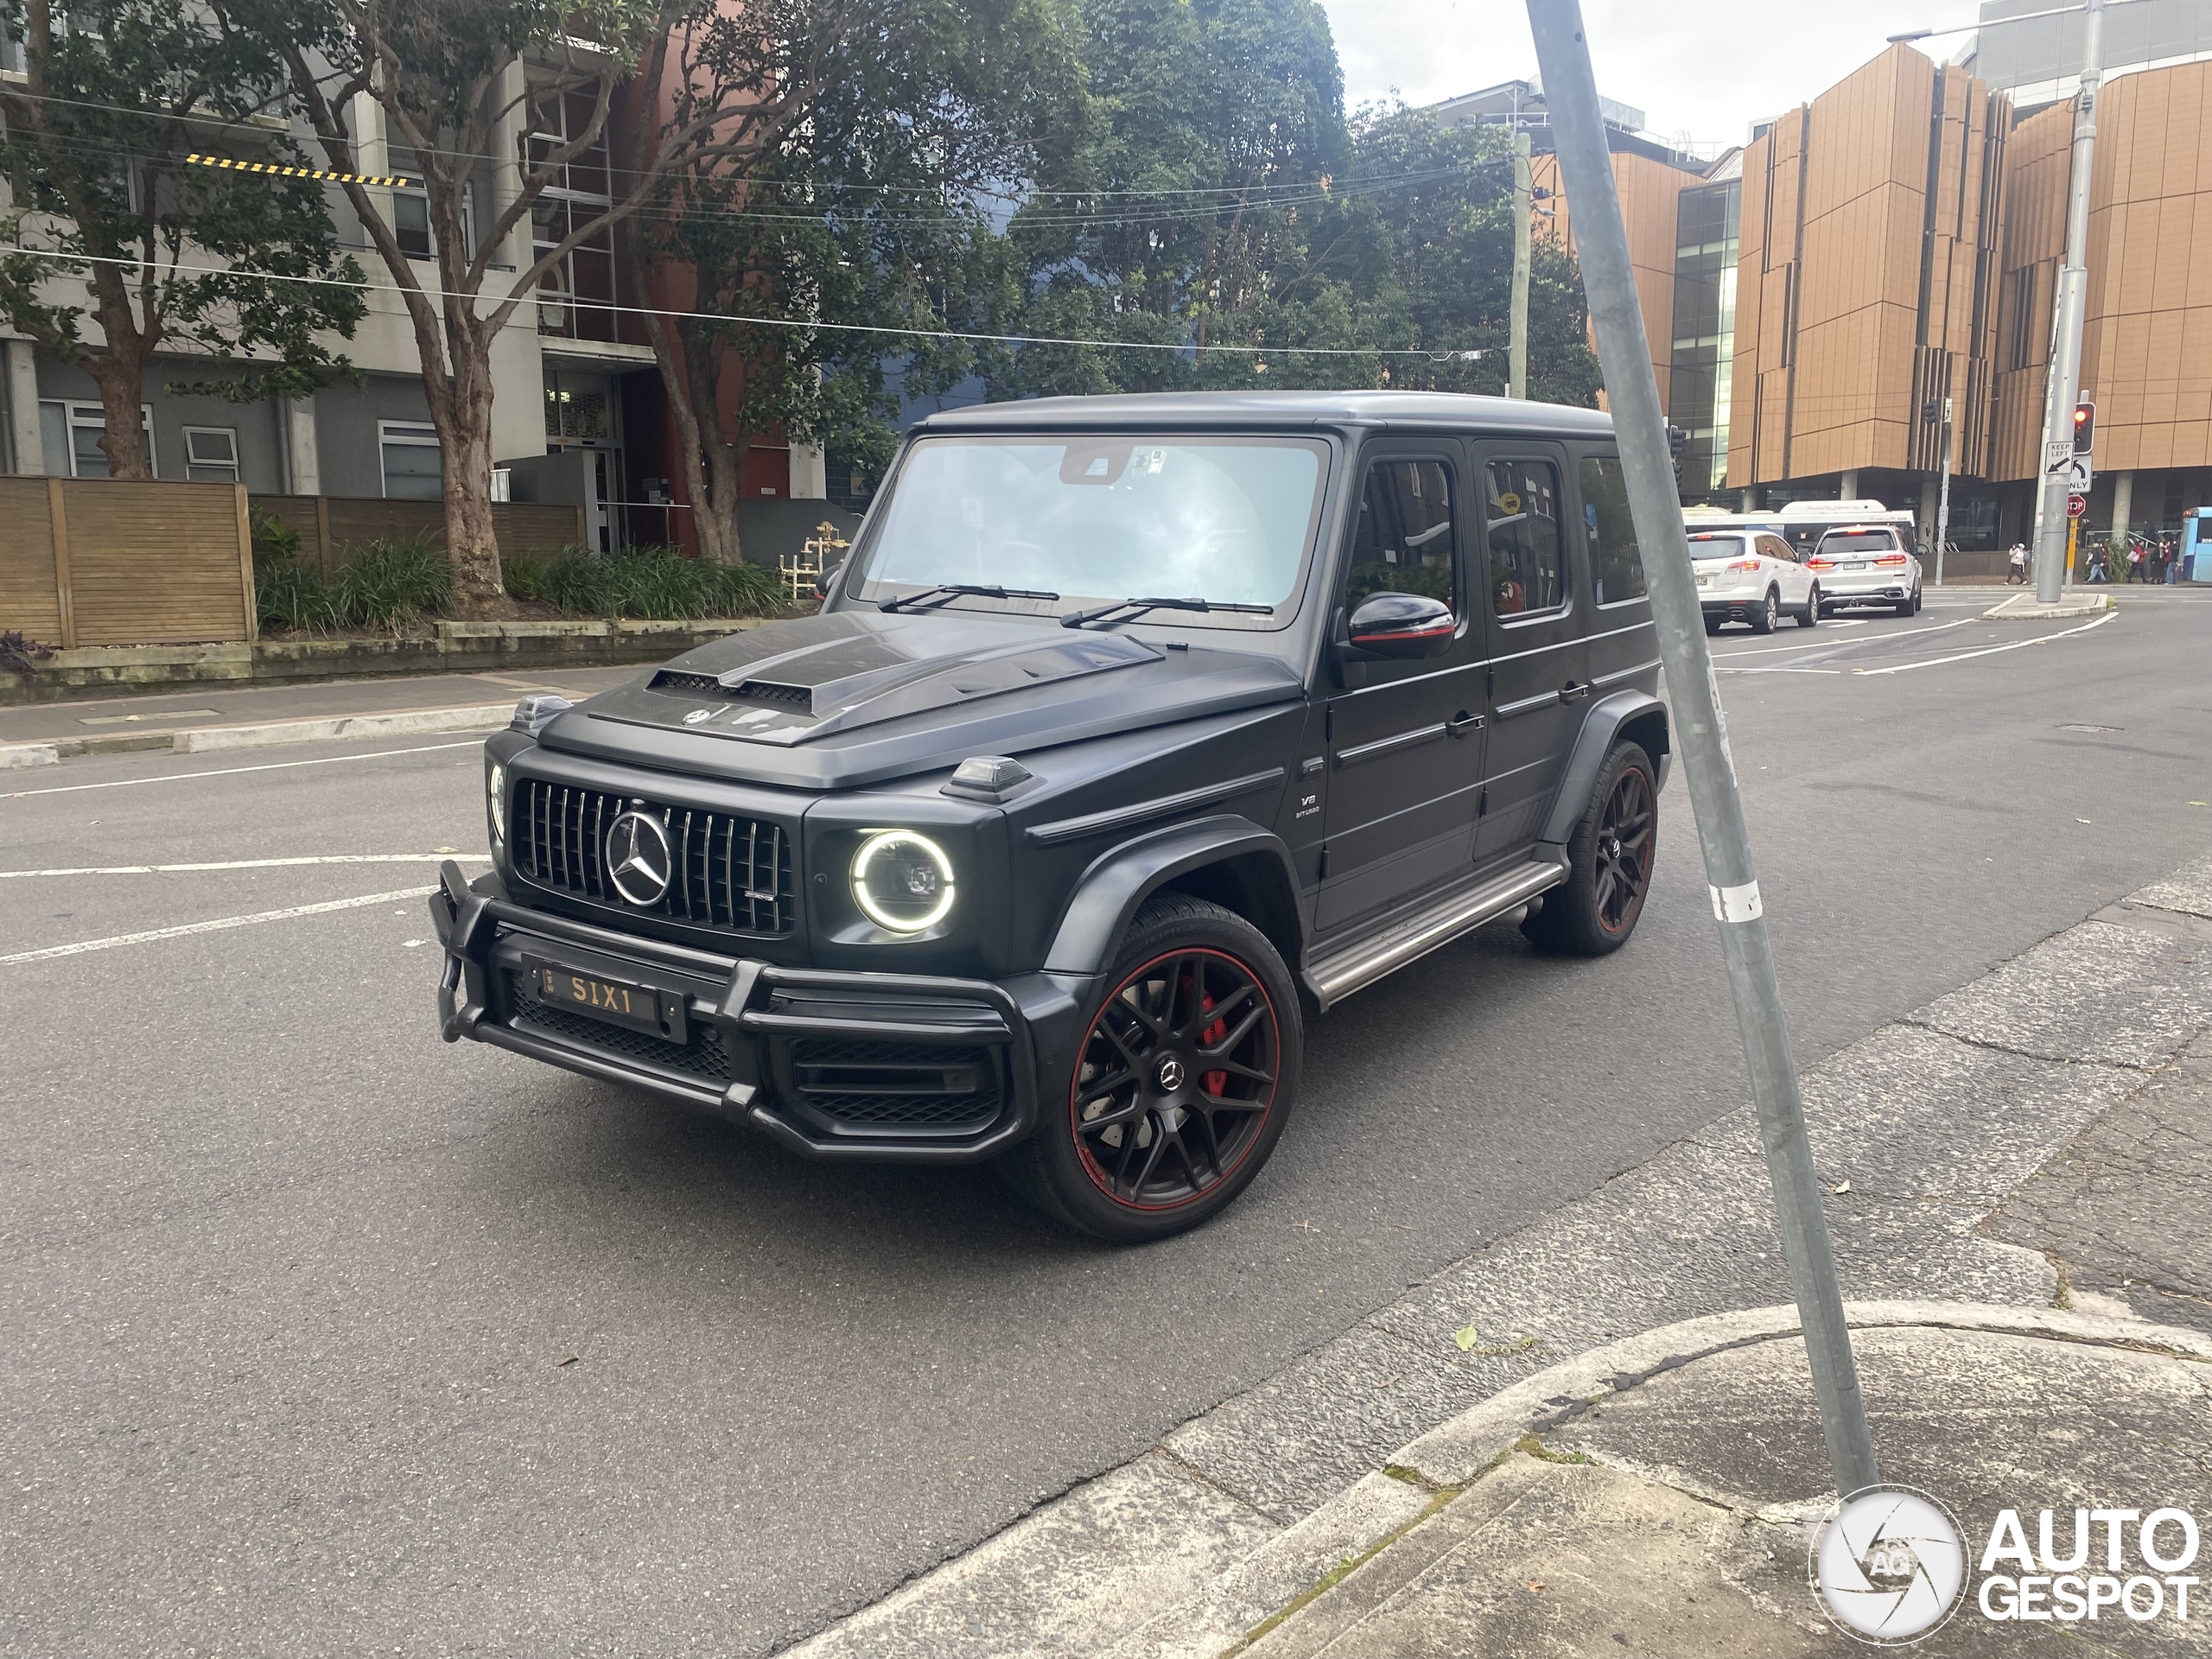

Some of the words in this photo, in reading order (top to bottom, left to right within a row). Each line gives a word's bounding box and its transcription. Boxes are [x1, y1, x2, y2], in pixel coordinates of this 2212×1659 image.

[1301, 795, 1315, 806] V8
[1296, 806, 1319, 818] BITURBO
[572, 976, 631, 1014] SIX1
